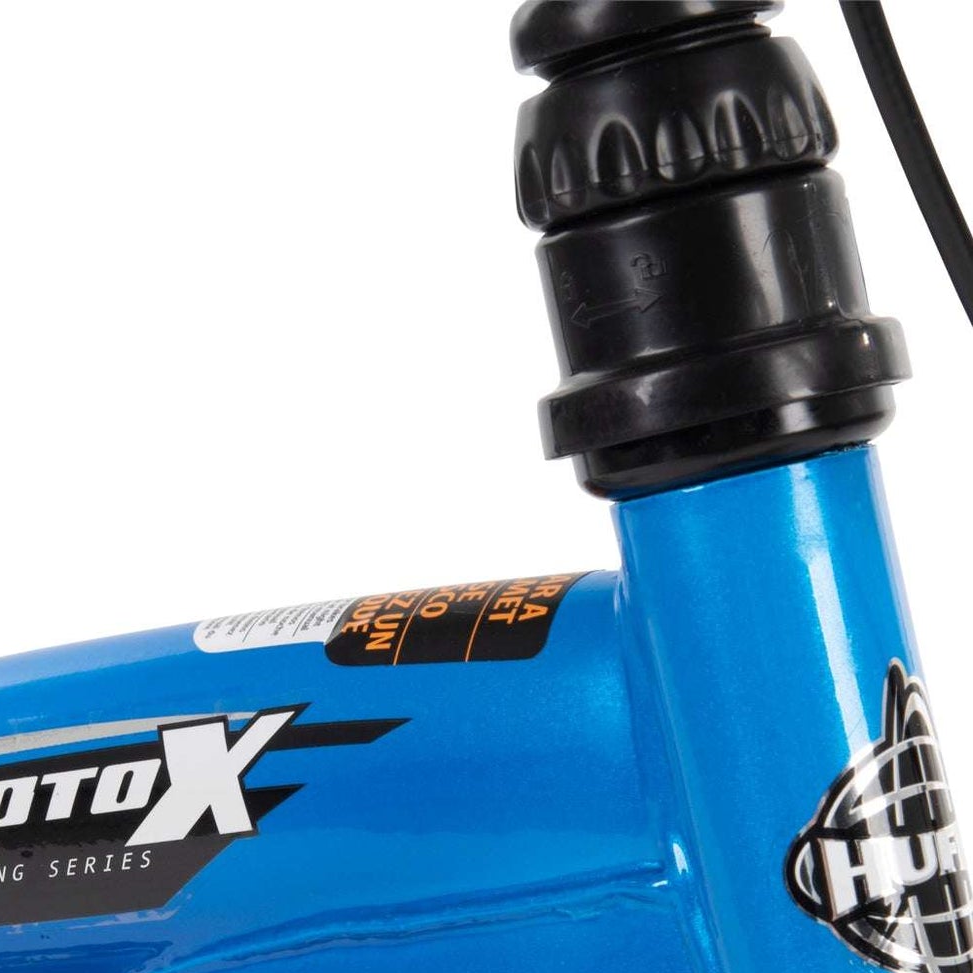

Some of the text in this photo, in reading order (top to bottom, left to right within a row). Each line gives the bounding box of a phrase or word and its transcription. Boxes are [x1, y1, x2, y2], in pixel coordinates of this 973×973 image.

[343, 594, 392, 633] QUE
[489, 578, 535, 624] MET
[518, 575, 572, 623] AR A
[365, 613, 404, 650] UN
[48, 850, 153, 879] SERIES
[818, 822, 965, 918] HUF
